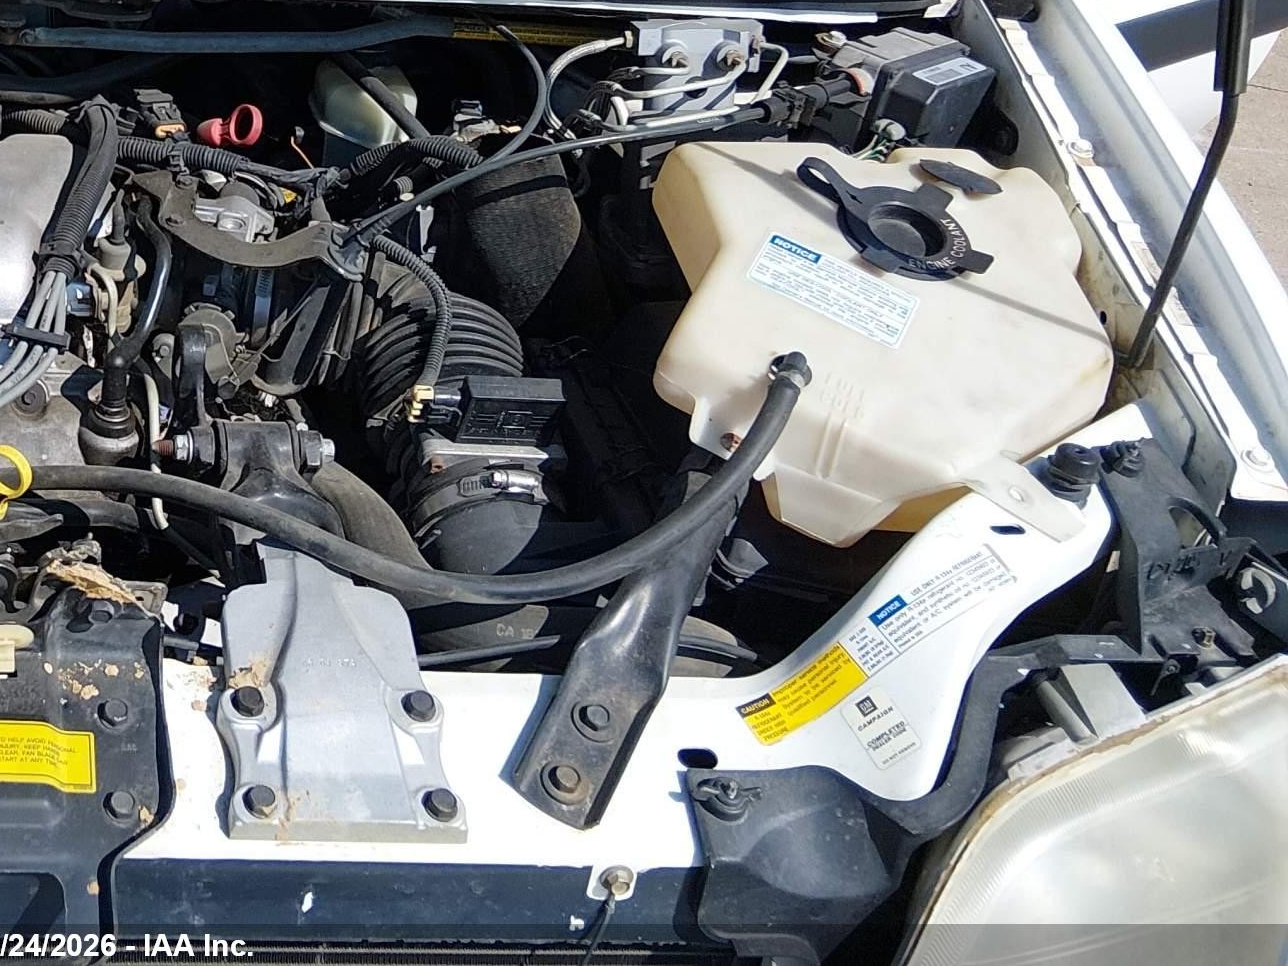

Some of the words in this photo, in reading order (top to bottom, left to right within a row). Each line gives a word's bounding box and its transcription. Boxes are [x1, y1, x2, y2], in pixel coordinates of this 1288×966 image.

[773, 236, 818, 262] NOTICE
[908, 256, 957, 271] ENGINE
[939, 217, 968, 258] COOLANT
[876, 599, 903, 621] NOTICE
[740, 698, 770, 715] CAUTION
[857, 705, 894, 732] CAMPAIGN
[47, 739, 76, 754] PERSONAL
[867, 720, 906, 748] COMPLETED
